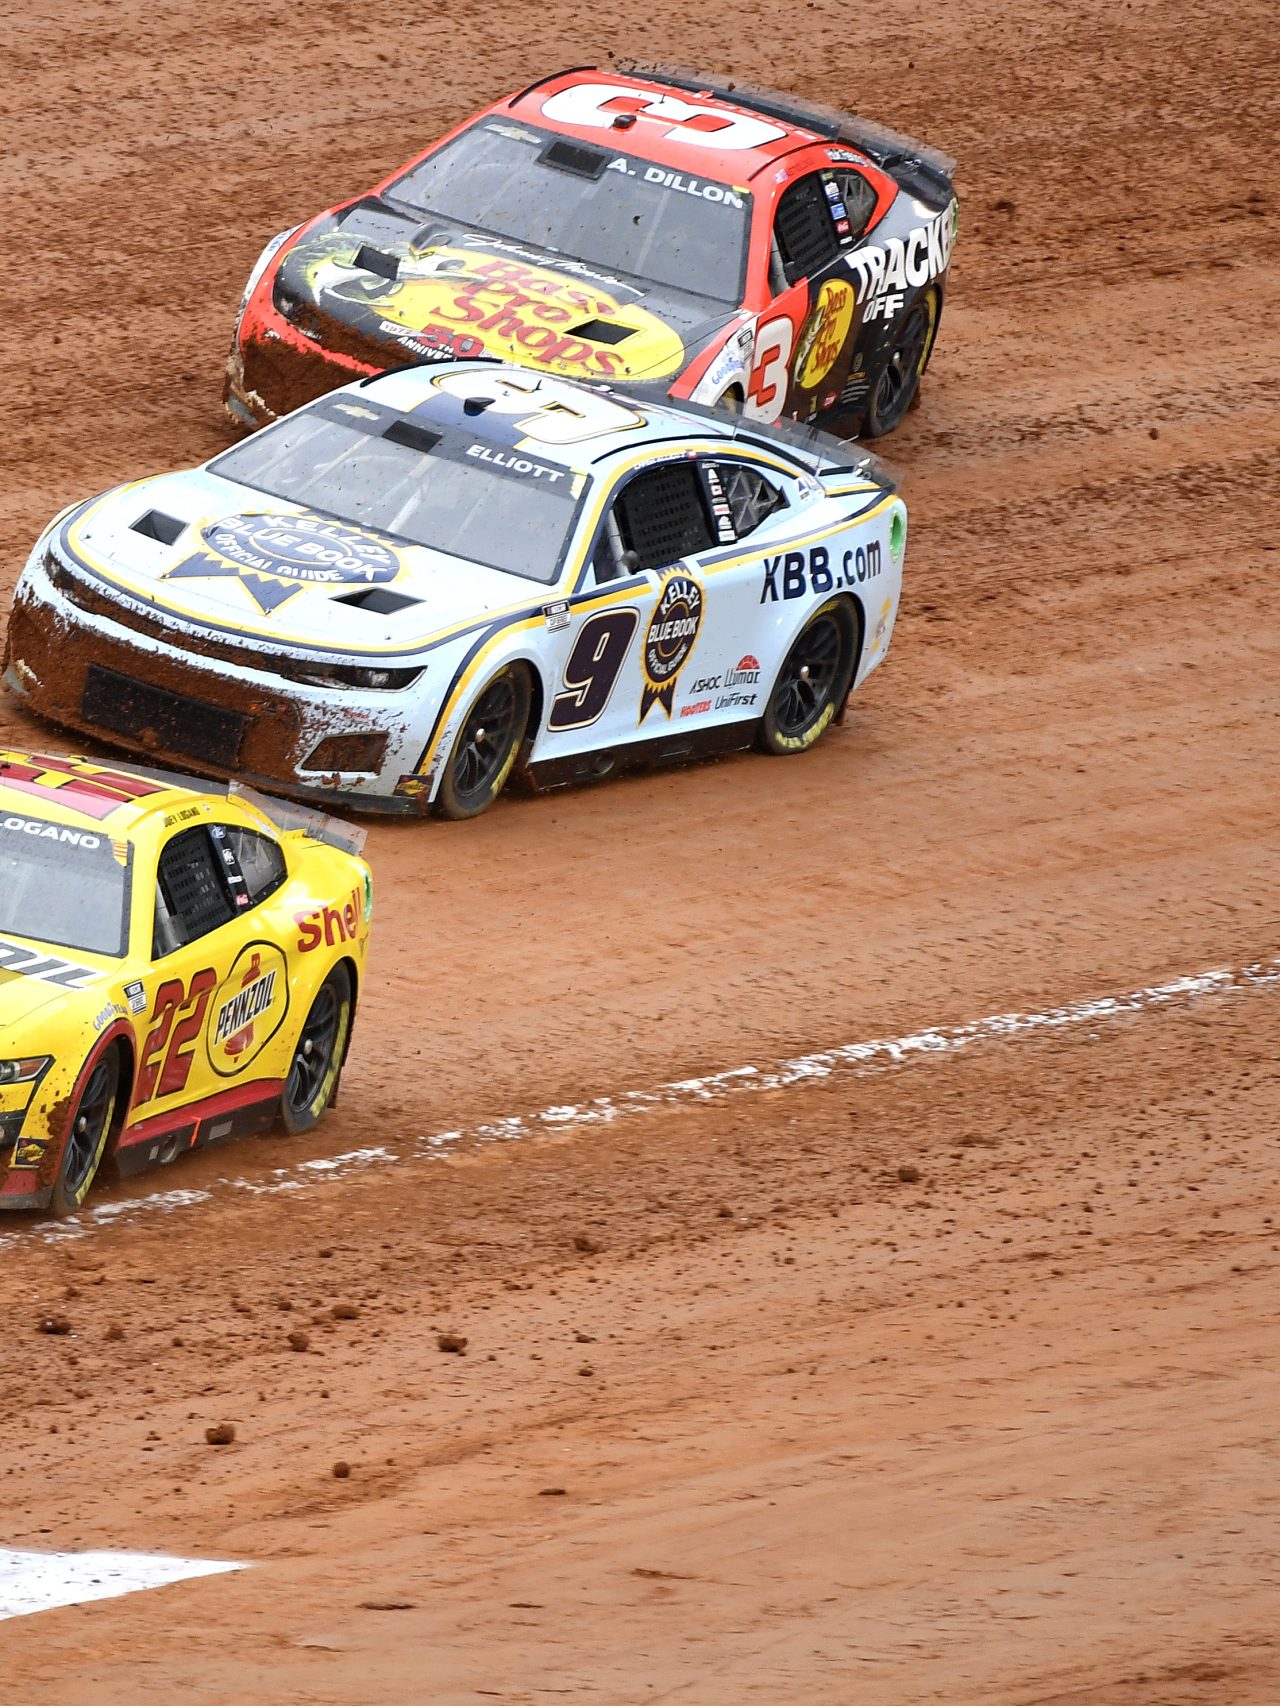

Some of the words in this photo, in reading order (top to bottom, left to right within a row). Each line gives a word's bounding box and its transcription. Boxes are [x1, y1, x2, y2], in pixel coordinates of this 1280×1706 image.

[540, 83, 788, 150] 3
[607, 158, 635, 176] A.
[644, 168, 743, 209] DILLON
[461, 272, 572, 323] Pro
[469, 259, 616, 316] Bass
[862, 293, 904, 323] OFF
[416, 323, 485, 357] 50
[428, 295, 625, 376] Shops
[745, 315, 794, 425] 3
[466, 444, 565, 483] ELLIOTT
[214, 533, 272, 570] OFFICIAL
[276, 564, 344, 582] GUIDE
[219, 514, 302, 548] BLUE
[294, 541, 388, 582] BOOK
[262, 514, 393, 564] KELLEY
[660, 580, 701, 616] KELLEY
[647, 620, 674, 644] BLUE
[672, 615, 700, 639] BOOK
[548, 608, 641, 733] 9
[647, 648, 670, 676] OFFICIAL
[689, 675, 722, 695] ASHOC
[714, 691, 758, 710] UniFirst
[214, 969, 277, 1046] PENNZOIL
[131, 966, 218, 1111] 22
